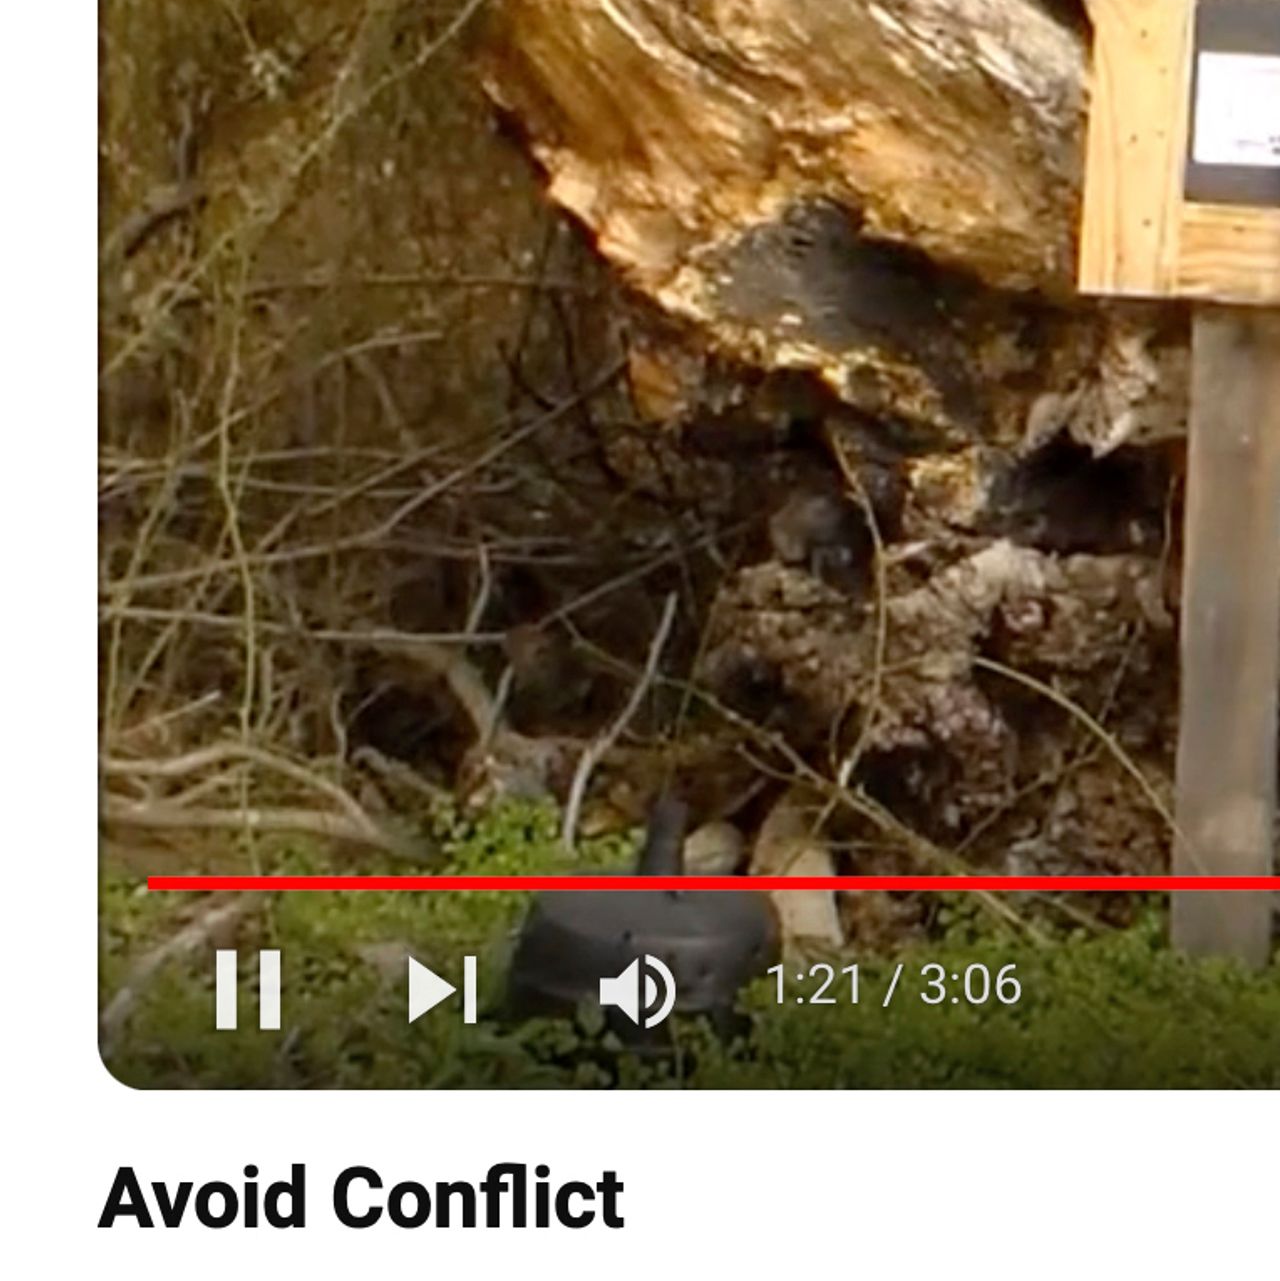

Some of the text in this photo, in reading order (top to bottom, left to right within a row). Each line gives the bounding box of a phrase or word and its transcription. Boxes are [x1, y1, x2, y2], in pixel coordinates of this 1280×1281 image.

[767, 963, 1021, 1007] 1:21 / 3:06
[97, 1161, 625, 1230] Avoid Conflict
